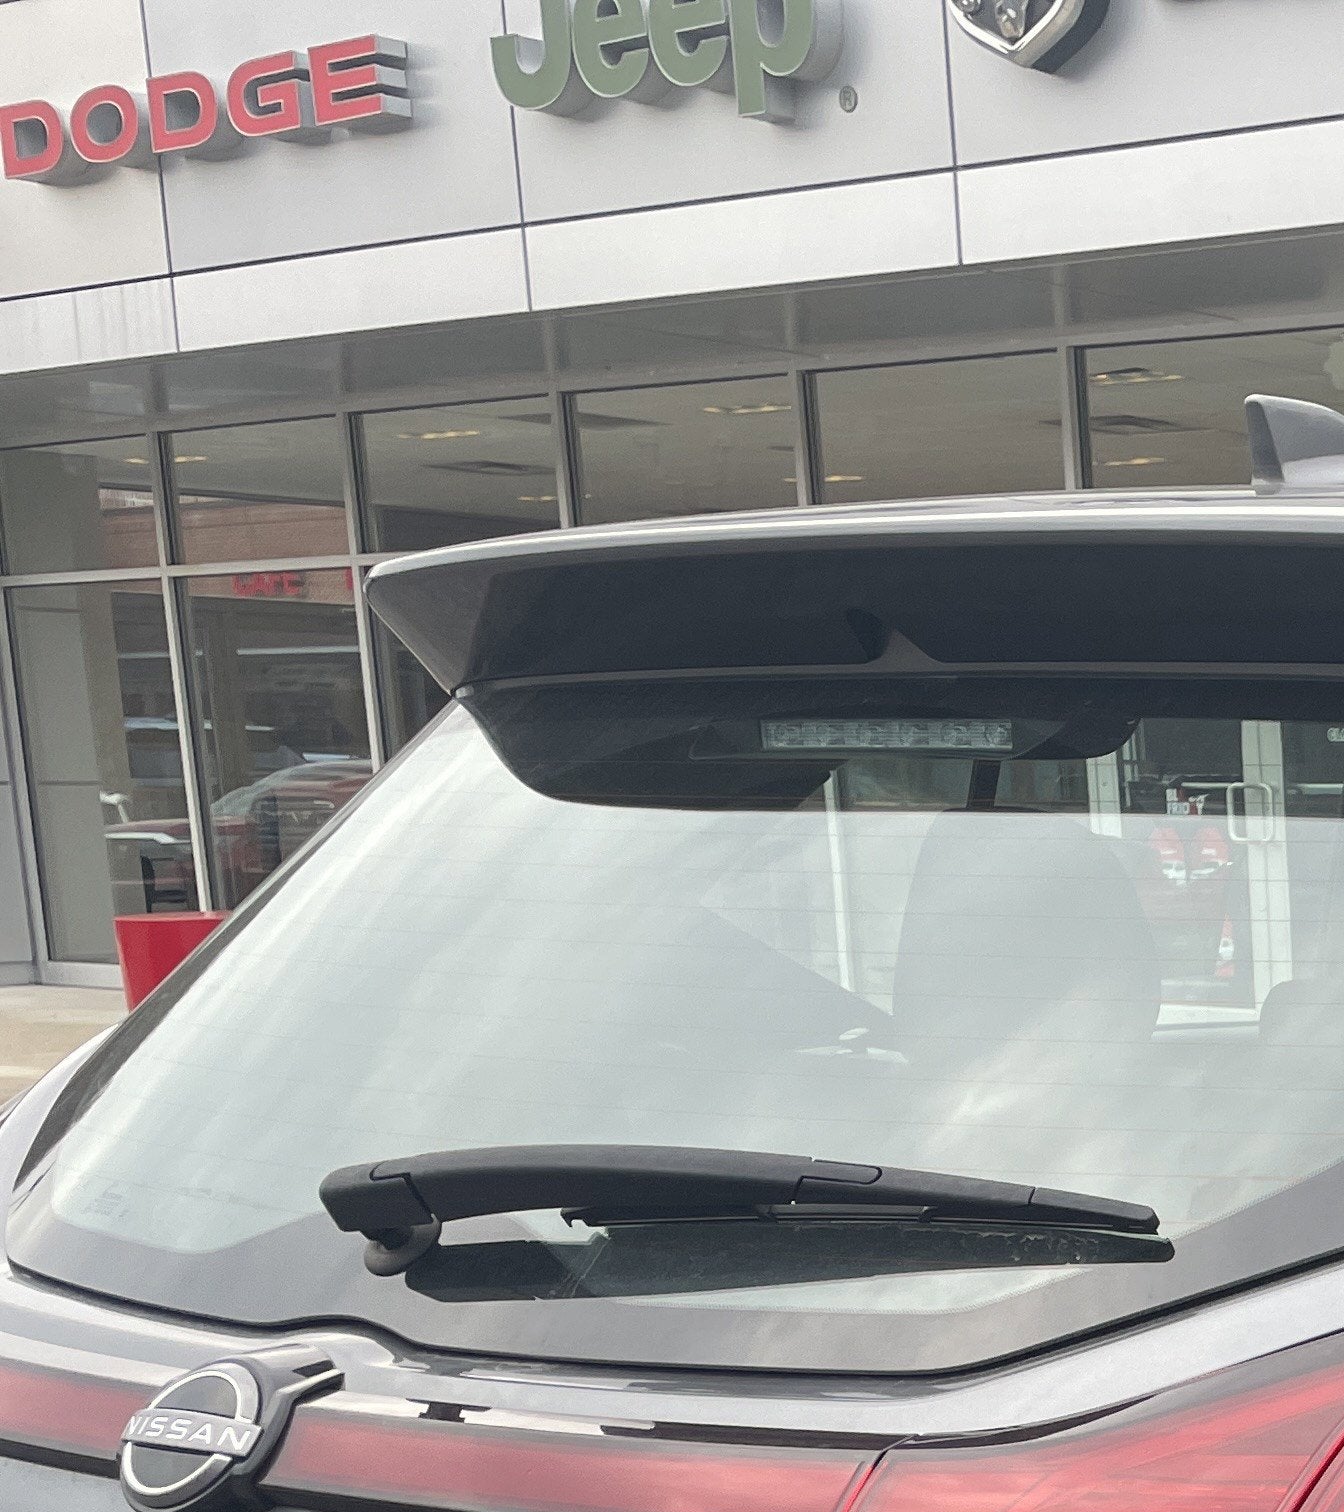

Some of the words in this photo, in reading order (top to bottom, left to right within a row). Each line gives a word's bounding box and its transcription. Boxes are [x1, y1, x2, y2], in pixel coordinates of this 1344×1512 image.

[0, 33, 384, 180] DODGE
[490, 0, 816, 117] Jeep
[121, 1415, 251, 1451] NISSAN
